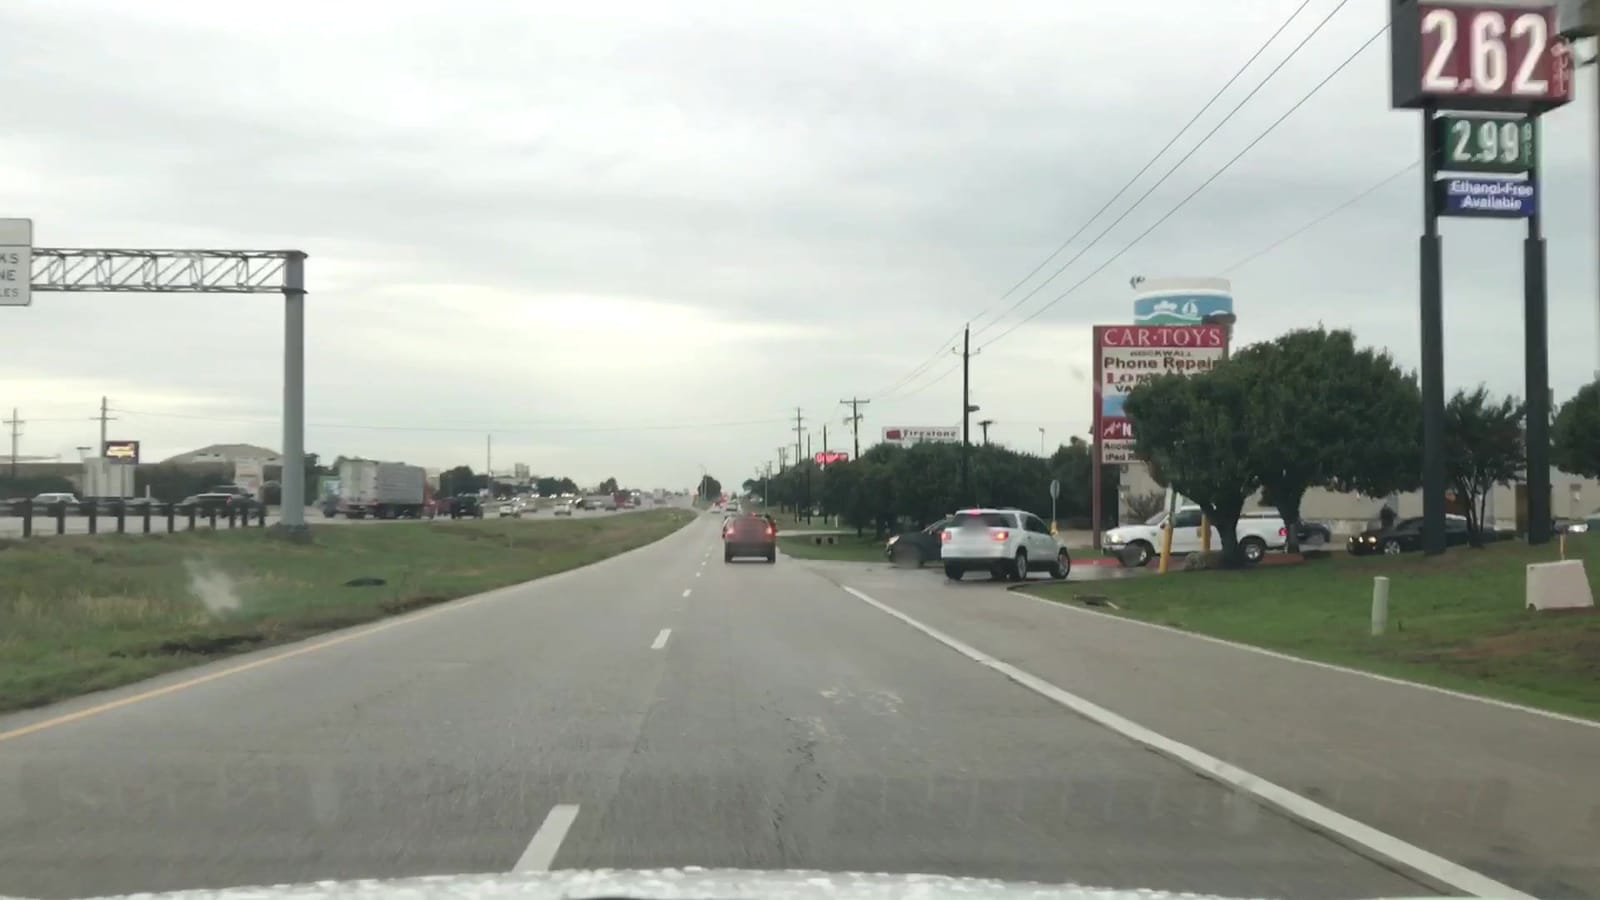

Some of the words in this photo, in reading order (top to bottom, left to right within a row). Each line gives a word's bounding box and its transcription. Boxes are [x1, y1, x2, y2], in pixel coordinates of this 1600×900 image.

[1421, 8, 1549, 95] 2.62
[1451, 119, 1519, 162] 2.99
[1450, 180, 1533, 197] Ethanol-Free
[1460, 195, 1522, 210] Available
[1104, 357, 1158, 369] Phone
[904, 429, 956, 438] Firestone
